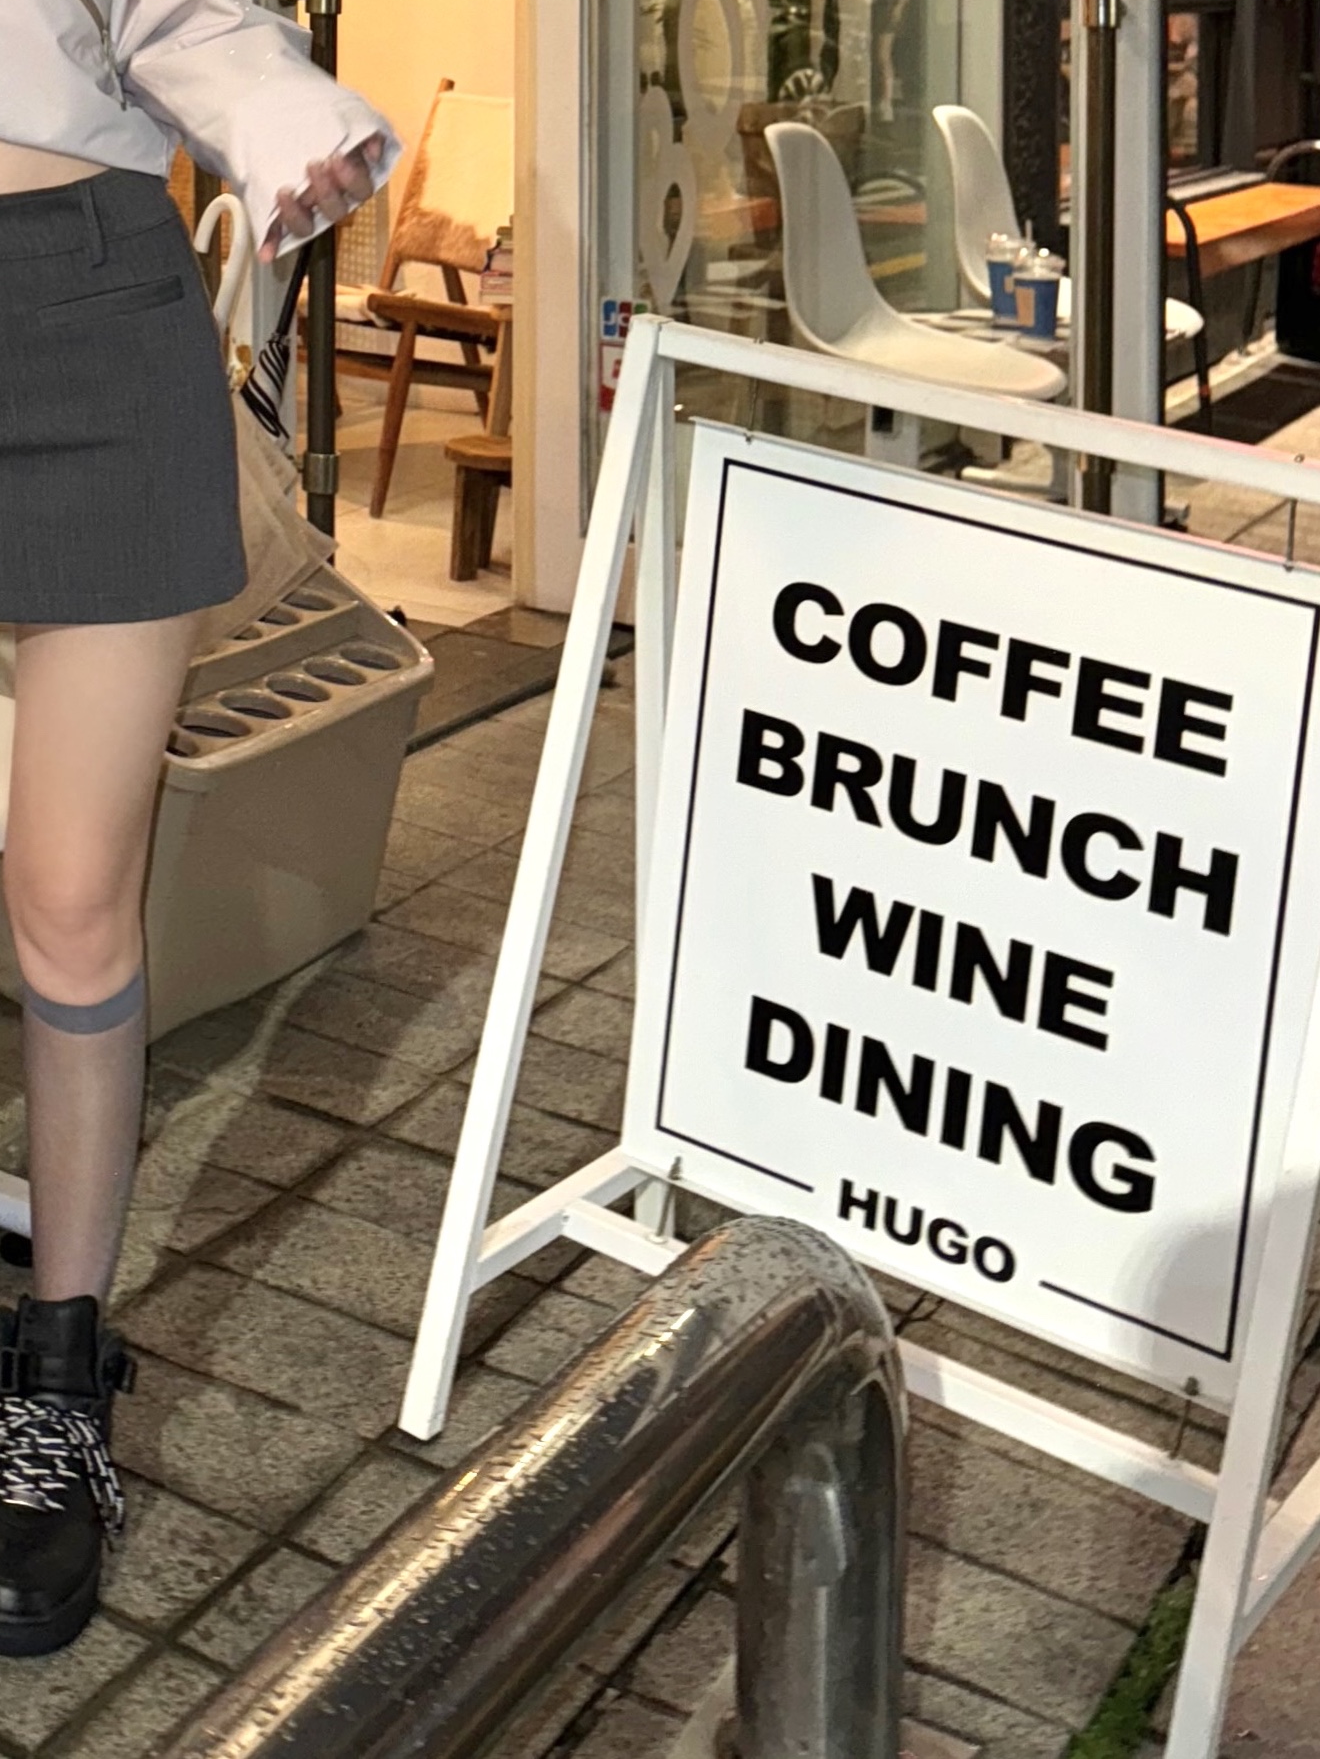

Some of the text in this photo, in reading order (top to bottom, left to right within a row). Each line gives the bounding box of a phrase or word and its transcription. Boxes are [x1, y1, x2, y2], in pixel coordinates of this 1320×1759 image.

[771, 580, 1234, 778] COFFEE
[735, 707, 1240, 938] BRUNCH
[811, 872, 1115, 1052] WINE
[744, 994, 1158, 1214] DINING
[837, 1178, 1016, 1283] HUGO
